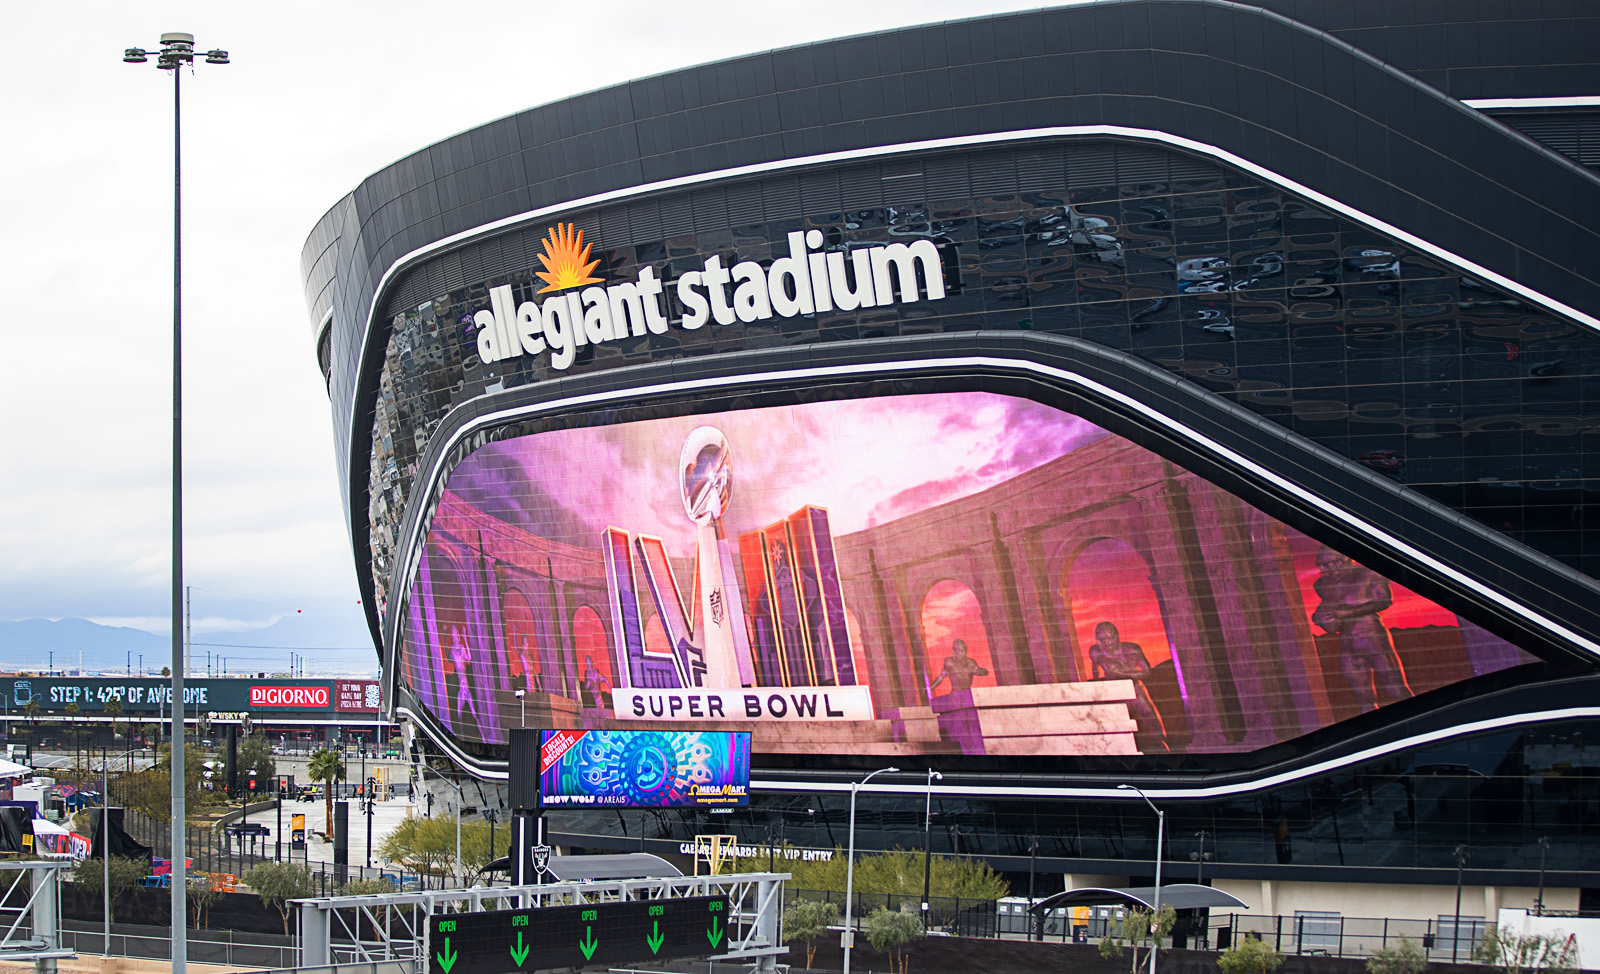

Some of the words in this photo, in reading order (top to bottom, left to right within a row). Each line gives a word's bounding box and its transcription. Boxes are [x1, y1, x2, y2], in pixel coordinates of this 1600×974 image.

[474, 265, 669, 370] allegiant
[677, 229, 946, 330] stadium
[50, 686, 81, 703] STEP
[128, 687, 145, 704] OF
[147, 687, 208, 704] AWEOME
[632, 694, 725, 718] SUPER
[743, 693, 844, 718] BOWL
[544, 733, 566, 755] LOCALS
[543, 735, 576, 767] DISCOUNTS!
[543, 795, 569, 804] MEOW
[570, 795, 595, 804] WOLF
[696, 797, 739, 805] omegamart.com
[783, 849, 801, 860] VIP
[803, 850, 833, 862] ENTRY
[648, 905, 664, 917] OPEN
[708, 901, 723, 912] OPEN
[512, 915, 529, 927] OPEN
[581, 910, 598, 921] OPEN
[438, 920, 457, 933] OPEN
